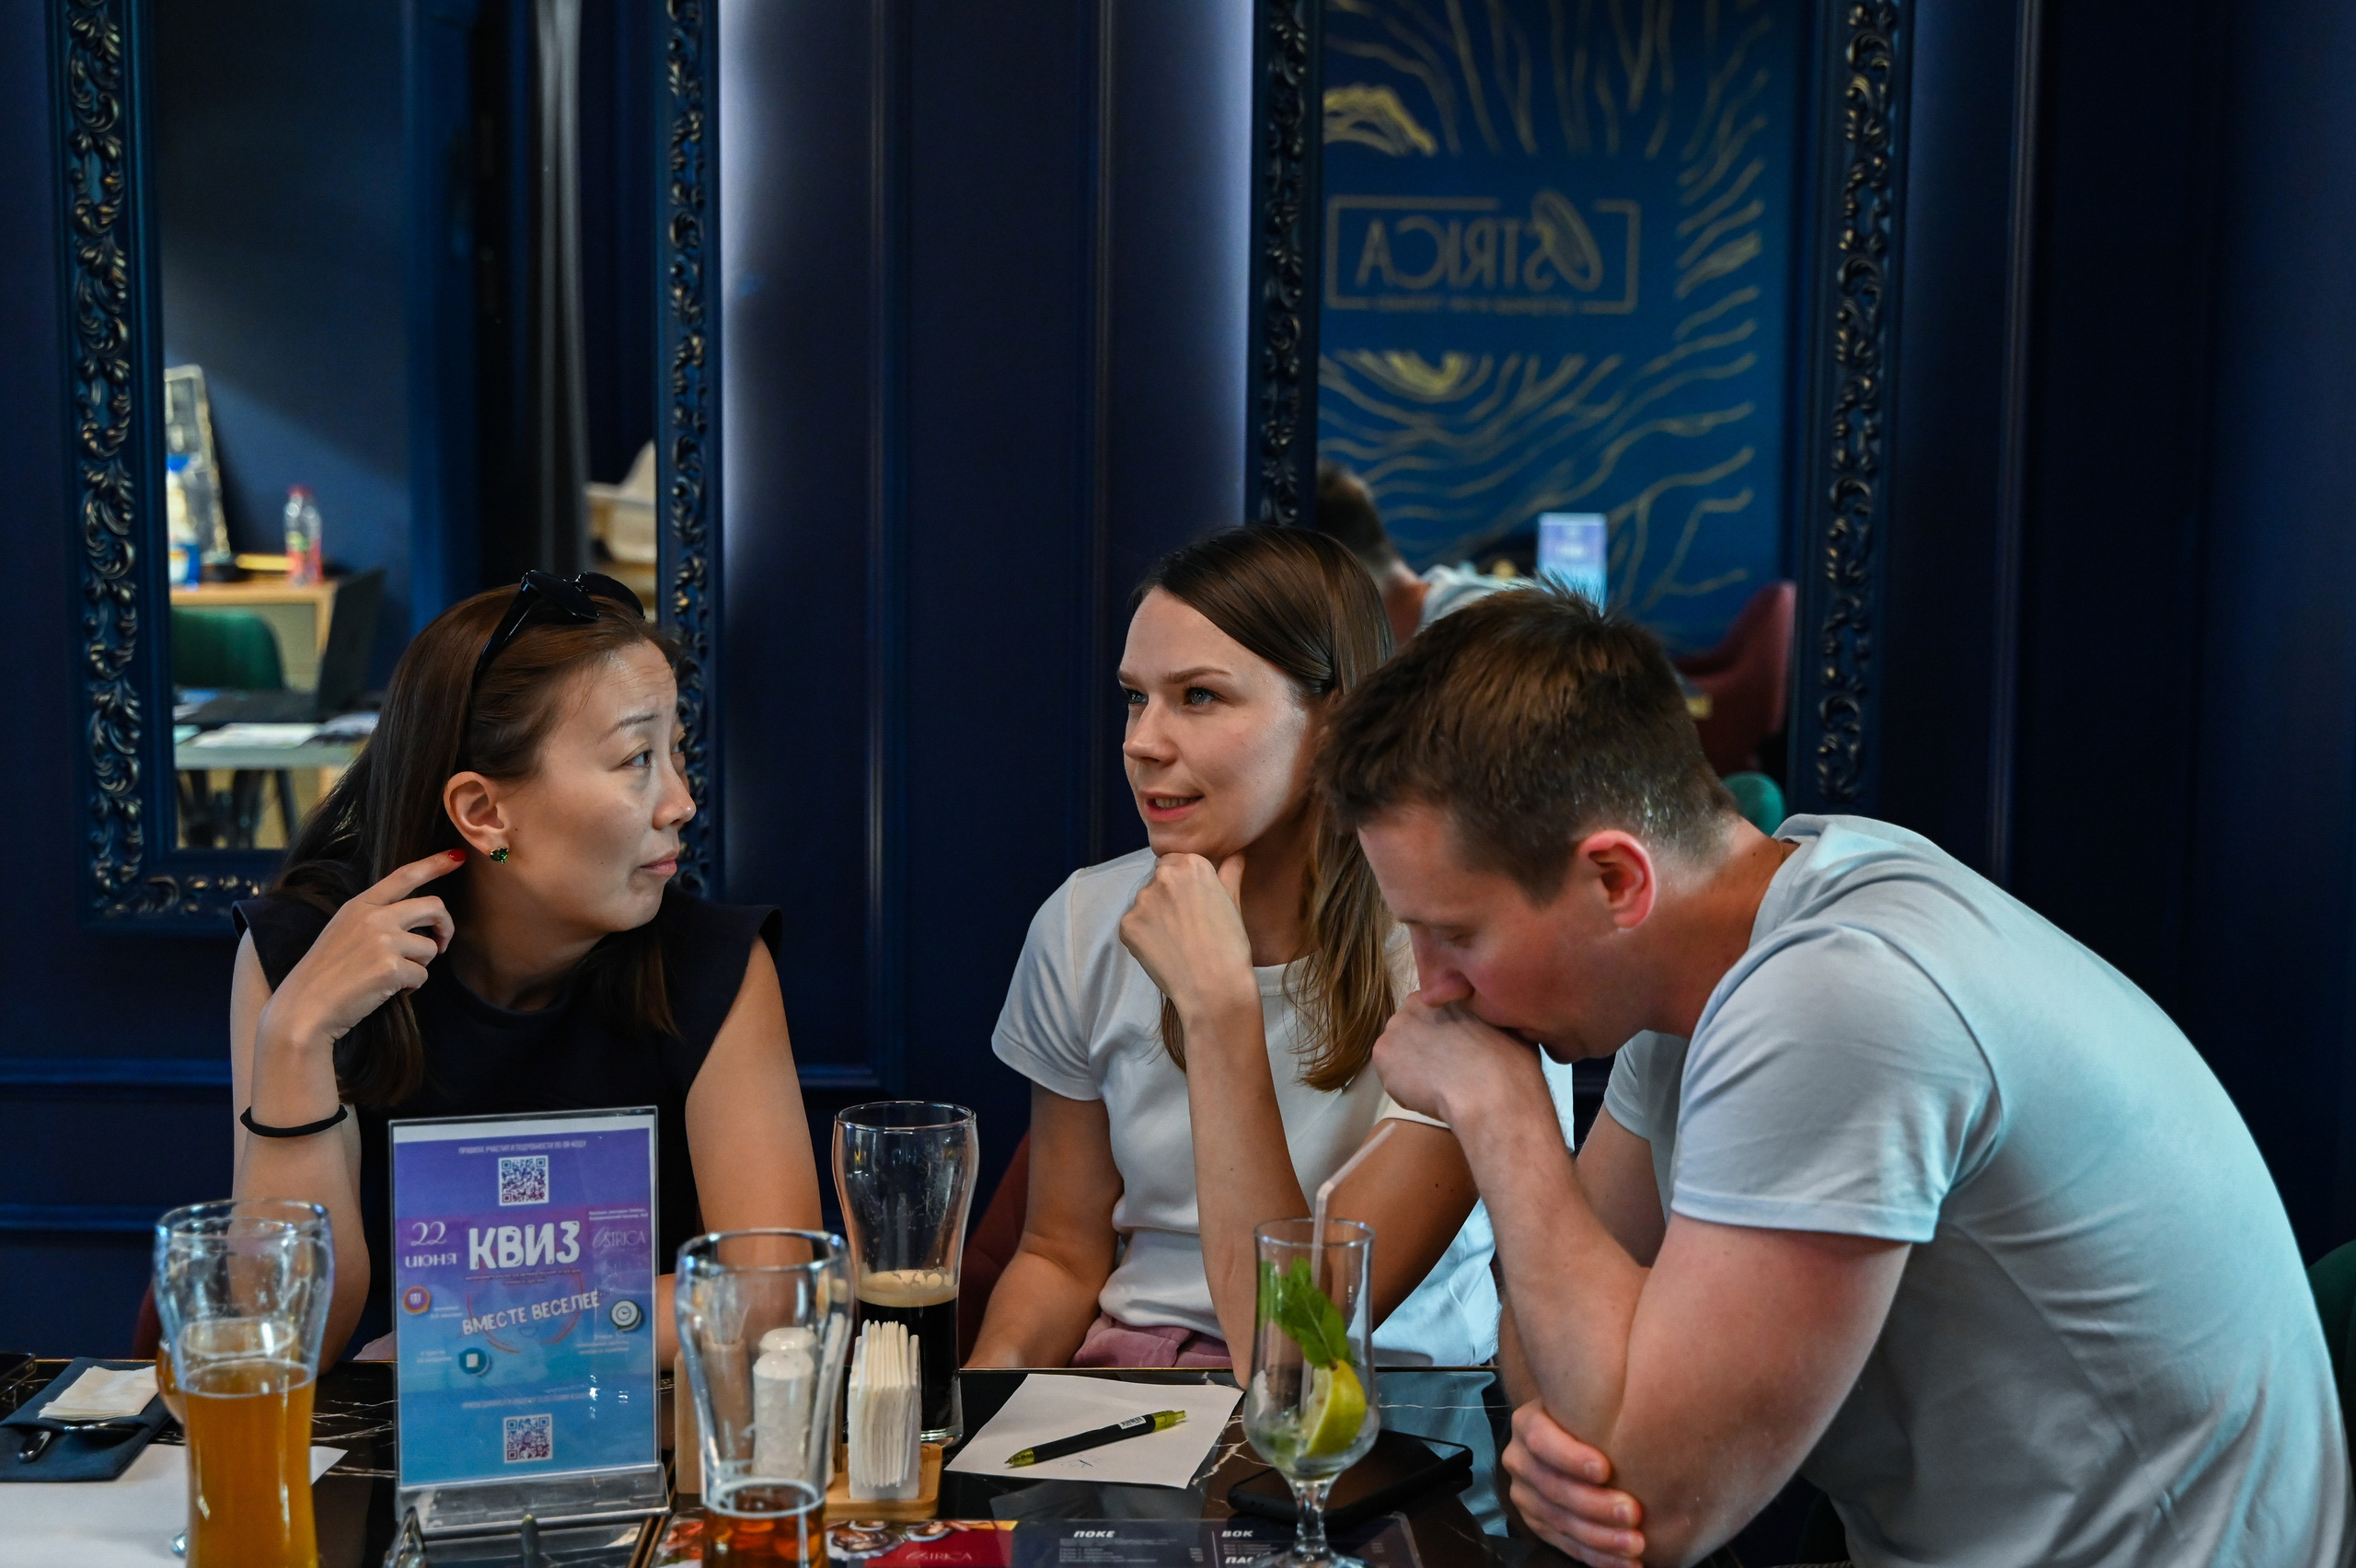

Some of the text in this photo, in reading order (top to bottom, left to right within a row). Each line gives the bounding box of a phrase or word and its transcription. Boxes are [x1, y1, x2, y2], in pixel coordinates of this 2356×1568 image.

[410, 1221, 447, 1246] 22
[468, 1220, 581, 1270] КВИЗ
[1073, 1529, 1115, 1538] ПОКЕ
[1221, 1529, 1253, 1538] ВОК
